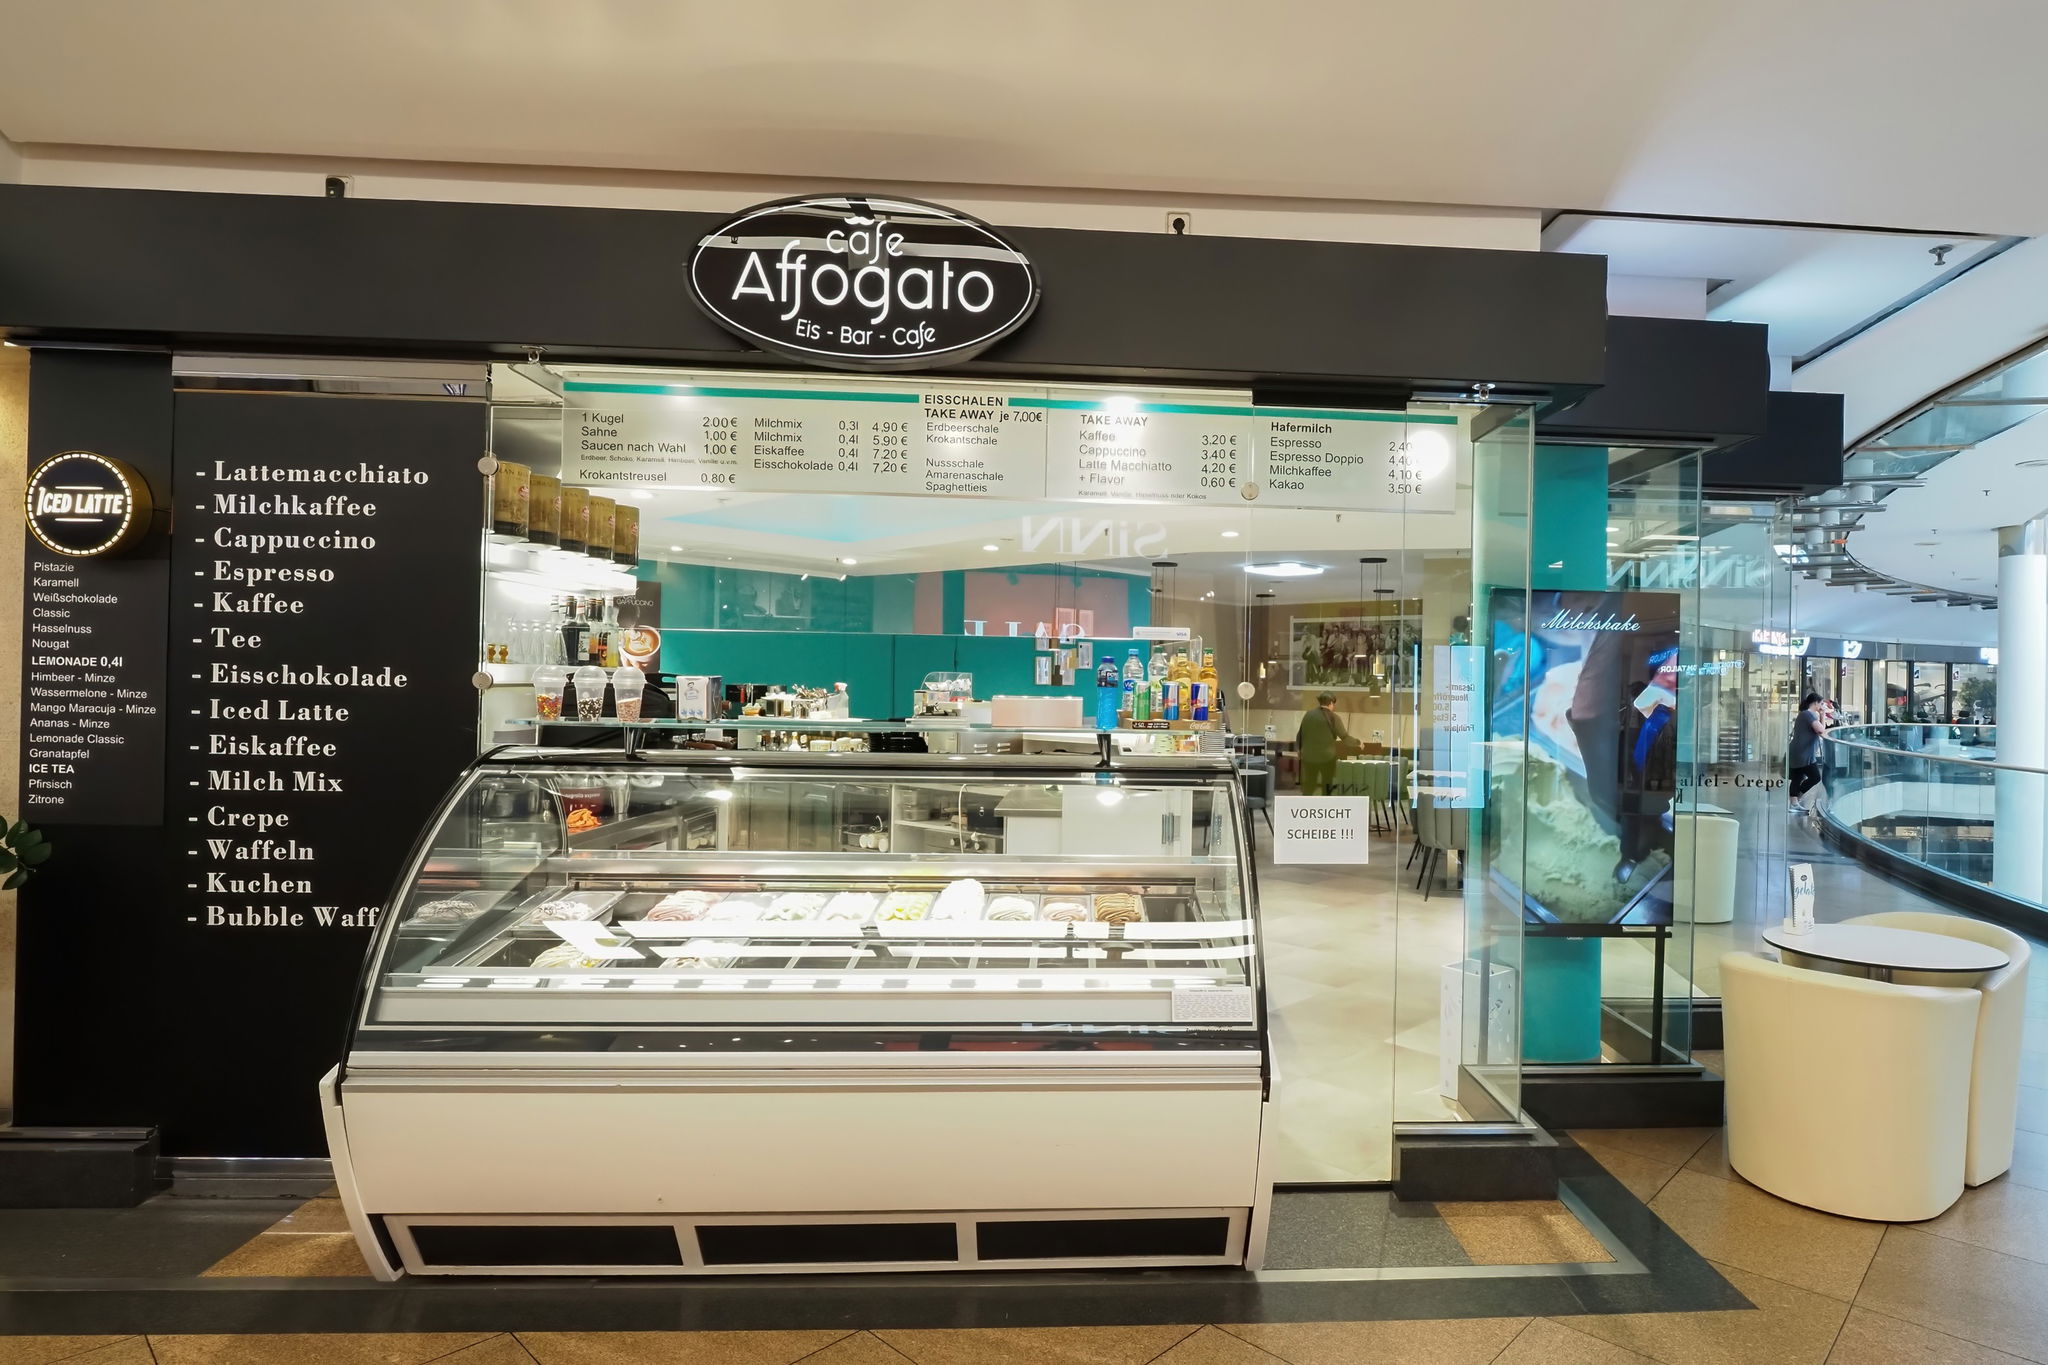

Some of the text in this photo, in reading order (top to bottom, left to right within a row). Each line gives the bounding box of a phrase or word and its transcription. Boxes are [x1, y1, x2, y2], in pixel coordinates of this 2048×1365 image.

[826, 221, 904, 265] cafe
[732, 240, 994, 324] Affogato
[796, 319, 820, 339] Eis
[841, 326, 872, 345] Bar
[893, 321, 935, 349] Cafe
[925, 395, 1003, 406] EISSCHALEN
[582, 413, 587, 422] 1
[592, 413, 624, 425] Kugel
[925, 408, 956, 418] TAKE
[960, 410, 994, 419] AWAY
[1000, 411, 1009, 422] je
[1081, 414, 1148, 426] TAKE AWAY
[755, 418, 802, 428] Milchmix
[927, 422, 999, 434] Erdbeerschale
[1271, 422, 1332, 433] Hafermilch
[581, 426, 617, 437] Sahne
[755, 432, 802, 442] Milchmix
[1079, 431, 1115, 441] Kaffee
[927, 434, 997, 445] Krokantschale
[1271, 437, 1322, 449] Espresso
[581, 440, 623, 450] Saucen
[627, 443, 654, 452] nach
[658, 443, 685, 452] Wahl
[755, 445, 804, 456] Eiskaffee
[1079, 444, 1146, 457] Cappuccino
[926, 458, 984, 468] Nussschale
[1270, 451, 1321, 463] Espresso
[1325, 453, 1364, 465] Doppio
[754, 459, 833, 470] Eisschokolade
[1079, 459, 1107, 469] Latte
[1111, 460, 1172, 471] Macchiatto
[214, 461, 428, 484] Lattemacchiato
[579, 469, 667, 481] Krokantstreusel
[926, 470, 1004, 480] Amarenaschale
[1270, 465, 1331, 476] Milchkaffee
[1089, 473, 1125, 484] Flavor
[926, 482, 987, 493] Spaghettieis
[1270, 479, 1304, 490] Kakao
[36, 487, 124, 516] ICED LATTE
[213, 494, 376, 516] Milchkaffee
[214, 527, 376, 554] Cappuccino
[34, 562, 74, 572] Pistazie
[213, 560, 334, 586] Espresso
[33, 577, 79, 587] Karamell
[33, 592, 118, 603] Weißschokolade
[212, 592, 304, 613] Kaffee
[33, 608, 70, 618] Classic
[1541, 609, 1640, 631] Milchshake
[32, 623, 92, 634] Hasselnuss
[210, 627, 262, 648] Tee
[32, 639, 69, 650] Nougat
[32, 656, 97, 666] LEMONADE
[31, 672, 115, 683] Himbeer Minze
[210, 663, 407, 687] Eisschokolade
[31, 688, 147, 699] Wassermelone Minze
[30, 702, 156, 715] Mango Maracuja Minze
[209, 698, 349, 721] Iced Latte
[30, 718, 110, 728] Ananas Minze
[30, 733, 124, 744] Lemonade Classic
[209, 735, 337, 756] Eiskaffee
[30, 748, 90, 760] Granatapfel
[29, 764, 75, 774] ICE TEA
[29, 779, 72, 789] Pfirsisch
[208, 770, 343, 792] Milch Mix
[28, 794, 64, 804] Zitrone
[207, 806, 289, 832] Crepe
[1291, 808, 1351, 819] VORSICHT
[1287, 829, 1354, 839] SCHEIBE !!!
[206, 839, 315, 860] Waffeln
[206, 873, 312, 893] Kuchen
[206, 906, 304, 926] Bubble
